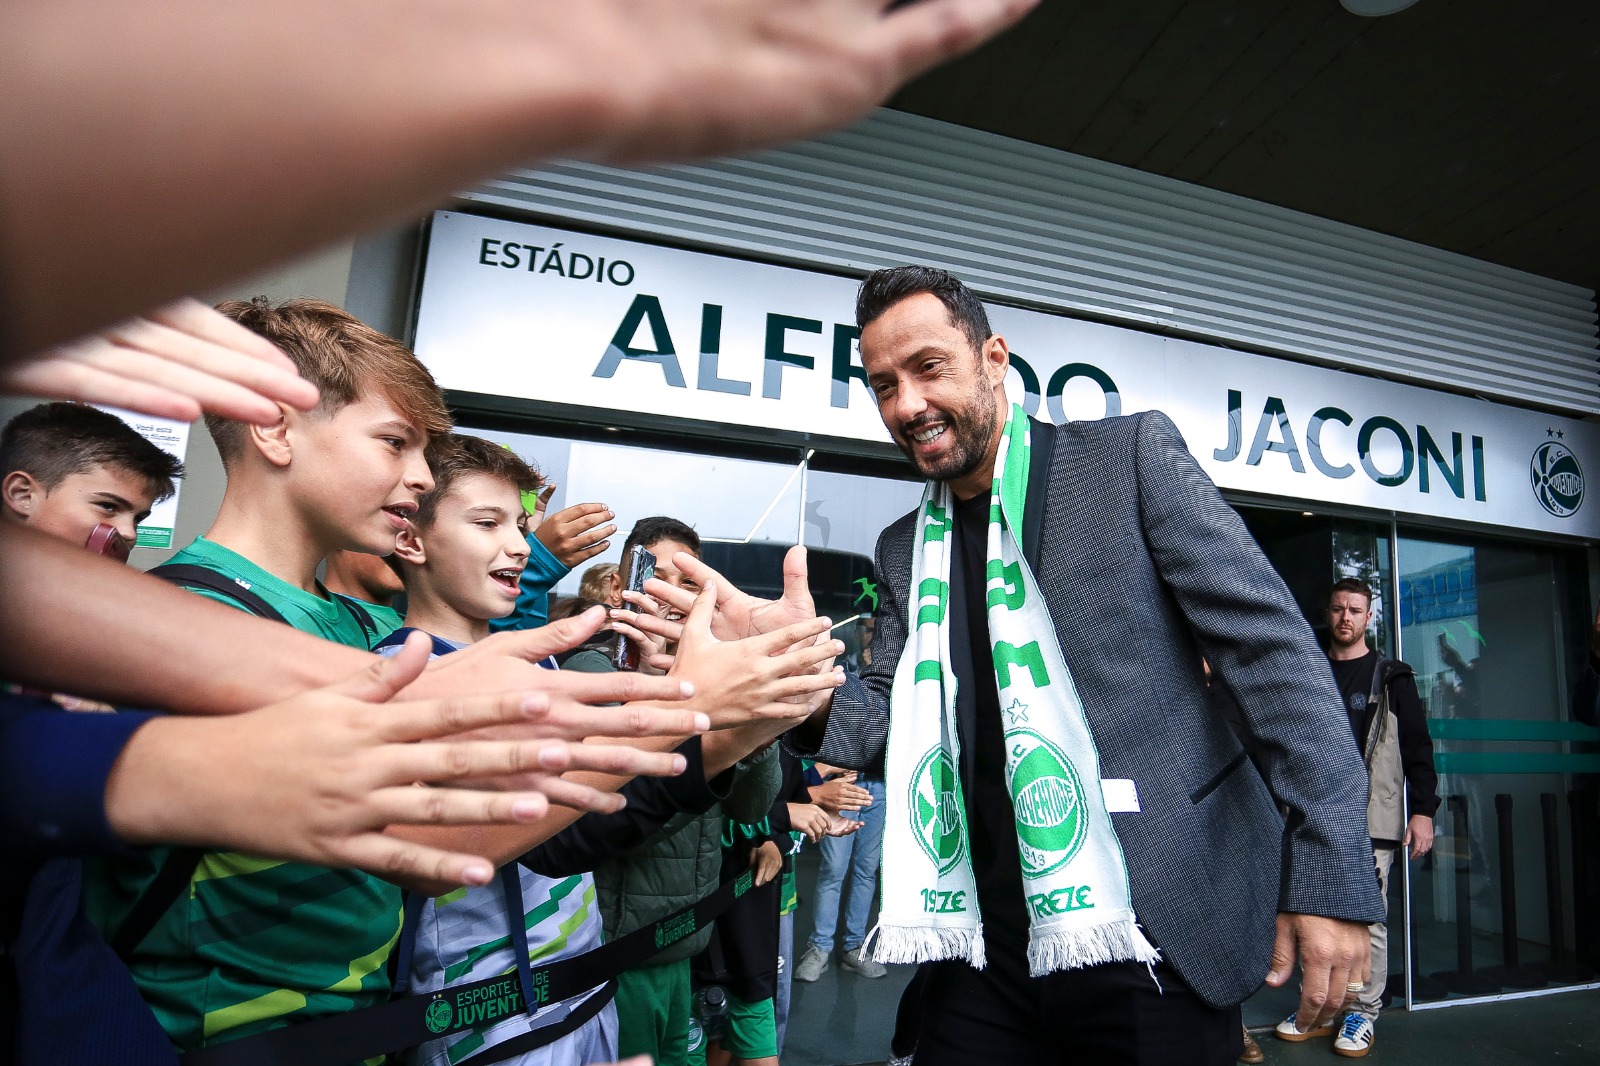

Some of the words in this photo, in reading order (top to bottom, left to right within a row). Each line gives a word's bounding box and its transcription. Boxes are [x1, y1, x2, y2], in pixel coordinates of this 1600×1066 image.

[478, 237, 635, 287] ESTÁDIO
[1213, 388, 1488, 502] JACONI
[453, 984, 550, 1029] JUVENTDE
[456, 980, 512, 1007] ESPORTE
